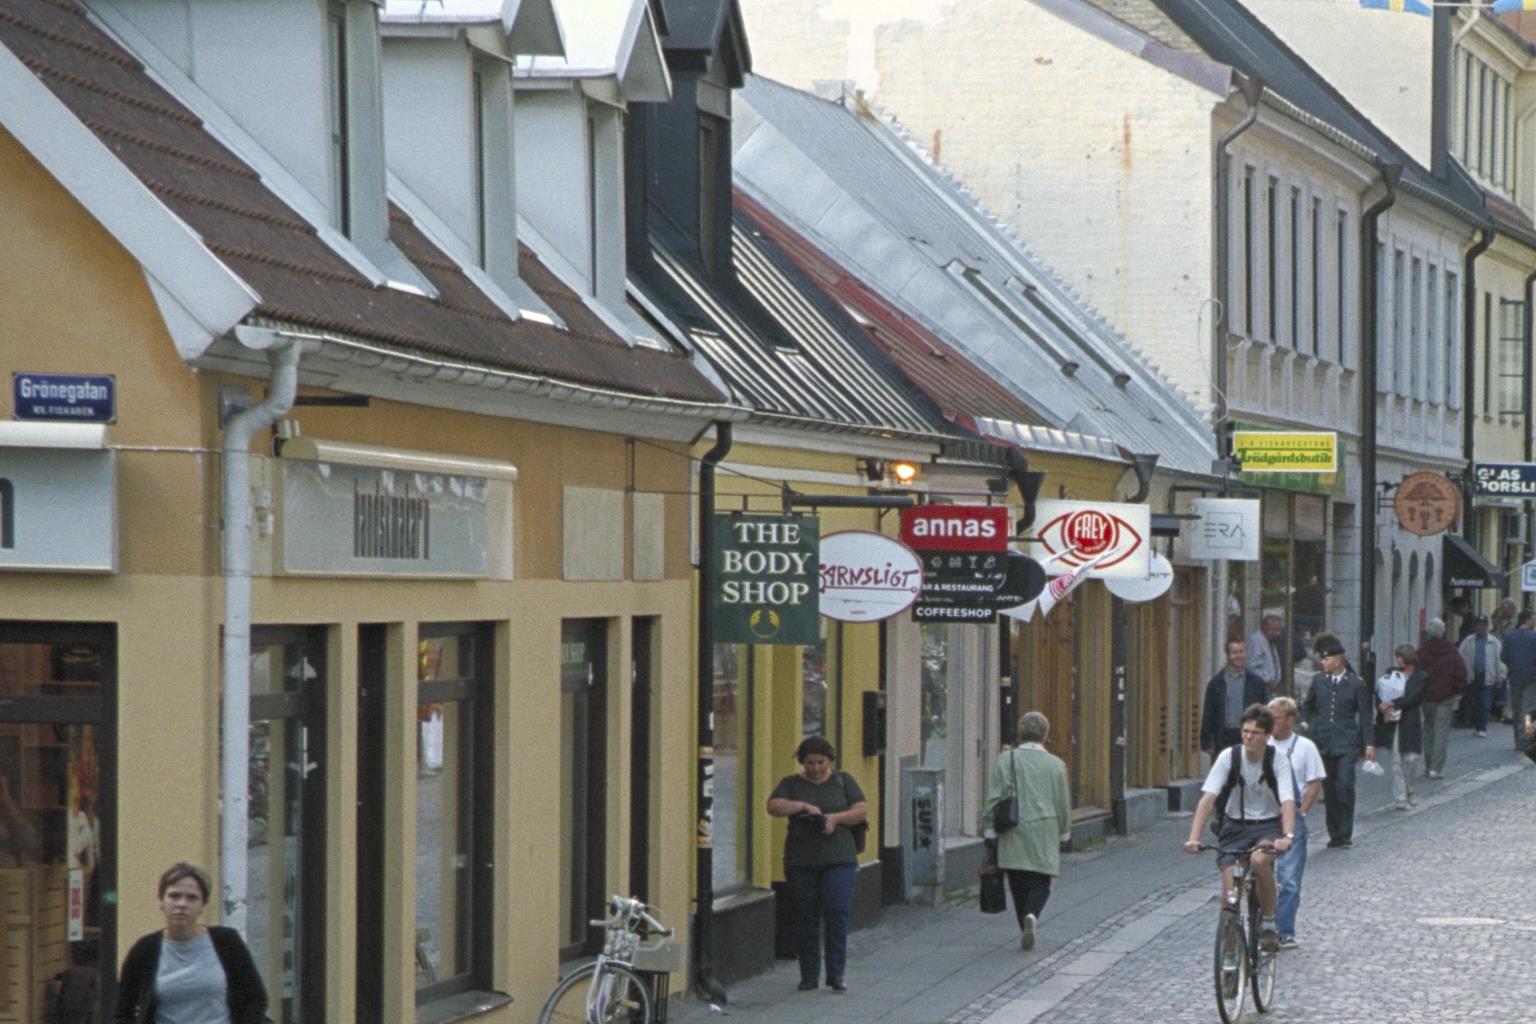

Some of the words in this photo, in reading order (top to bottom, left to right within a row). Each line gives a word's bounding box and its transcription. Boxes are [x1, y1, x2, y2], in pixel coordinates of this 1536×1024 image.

[21, 378, 108, 404] Grönegatan
[1238, 447, 1332, 465] Trädgårdsbutik
[734, 522, 801, 544] THE
[912, 518, 997, 538] annas
[1074, 513, 1108, 540] FREY
[1203, 523, 1247, 538] ERA
[722, 551, 813, 575] BODY
[722, 581, 810, 605] SHOP
[941, 584, 994, 592] RESTAURANG
[916, 607, 993, 618] COFFEESHOP
